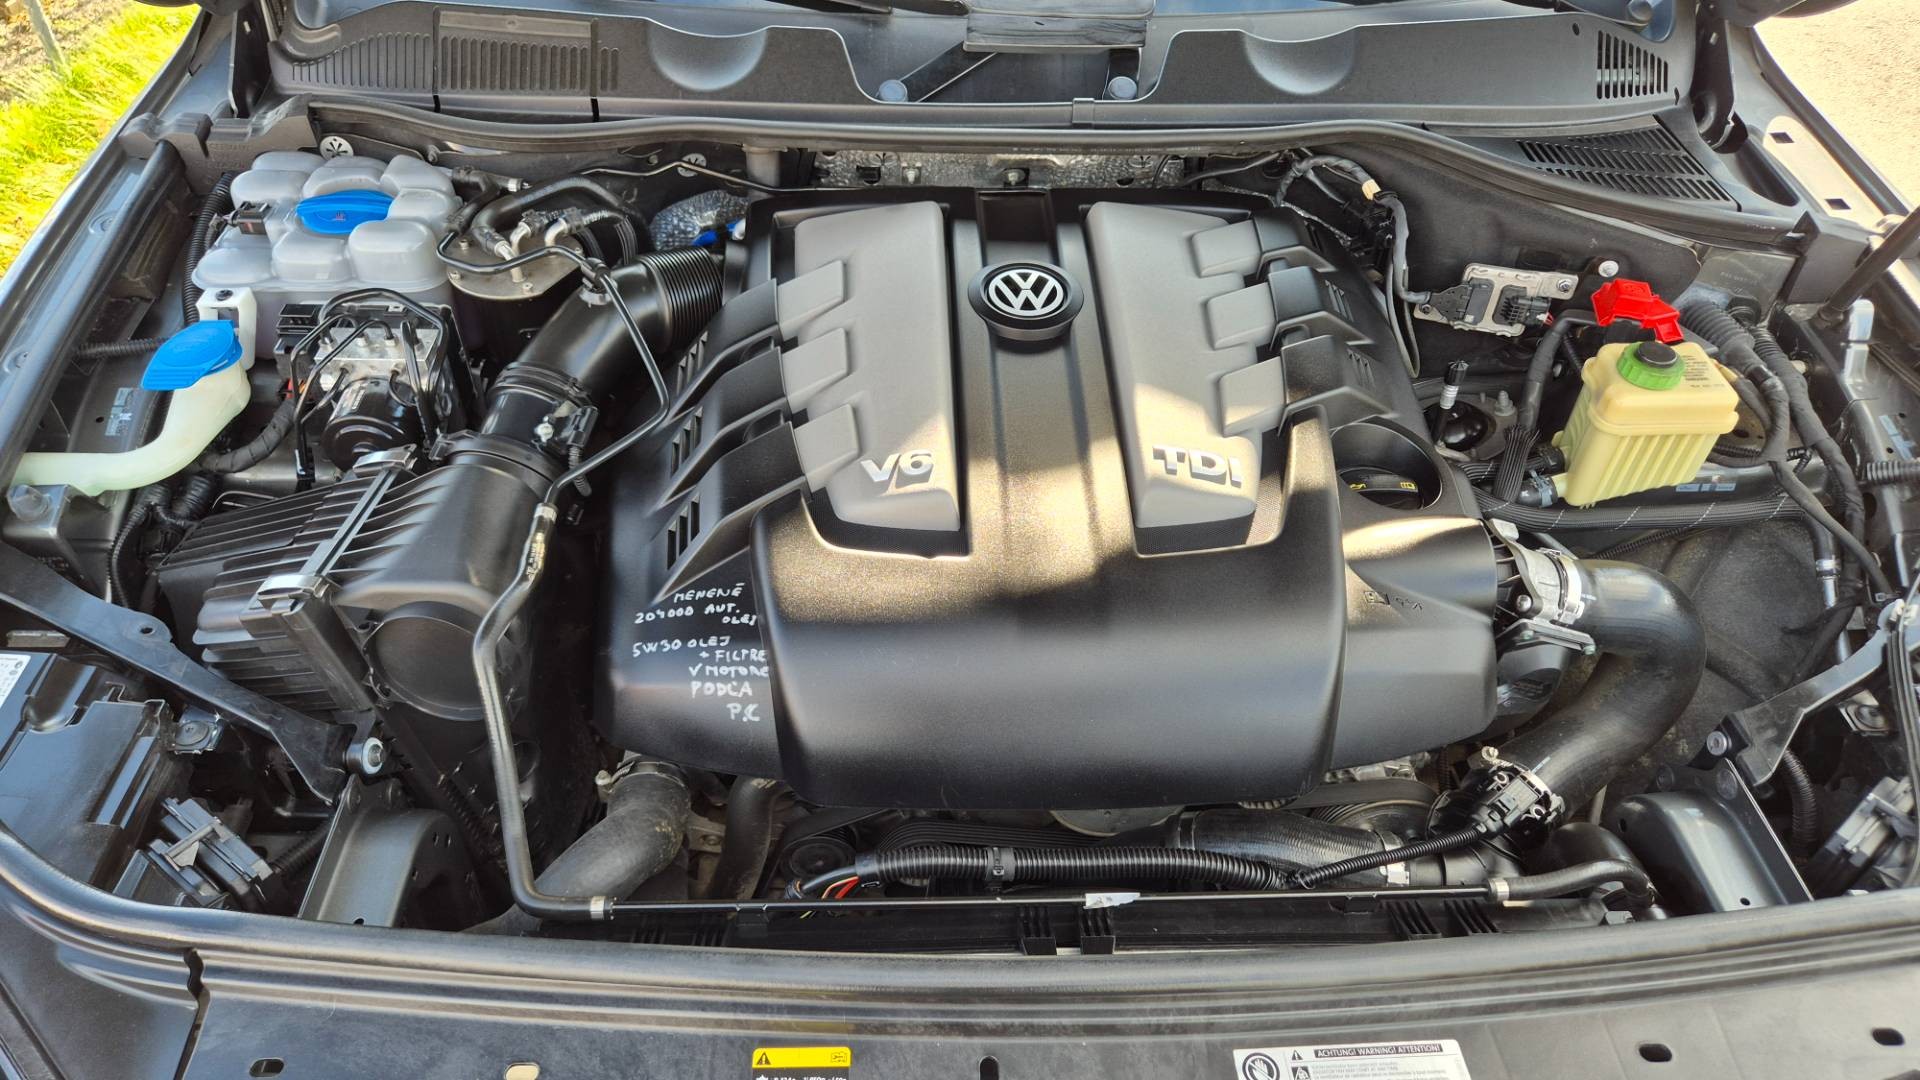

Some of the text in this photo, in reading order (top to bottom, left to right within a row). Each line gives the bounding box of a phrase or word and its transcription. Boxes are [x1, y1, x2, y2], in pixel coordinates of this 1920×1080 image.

[988, 268, 1064, 316] VW
[860, 449, 934, 482] V6
[1152, 445, 1242, 483] TDI
[721, 614, 757, 626] OLEJ
[631, 635, 731, 658] 5W30 OLEJ
[1317, 1043, 1441, 1057] ACHTUNG! WARNING! ATTENTION!
